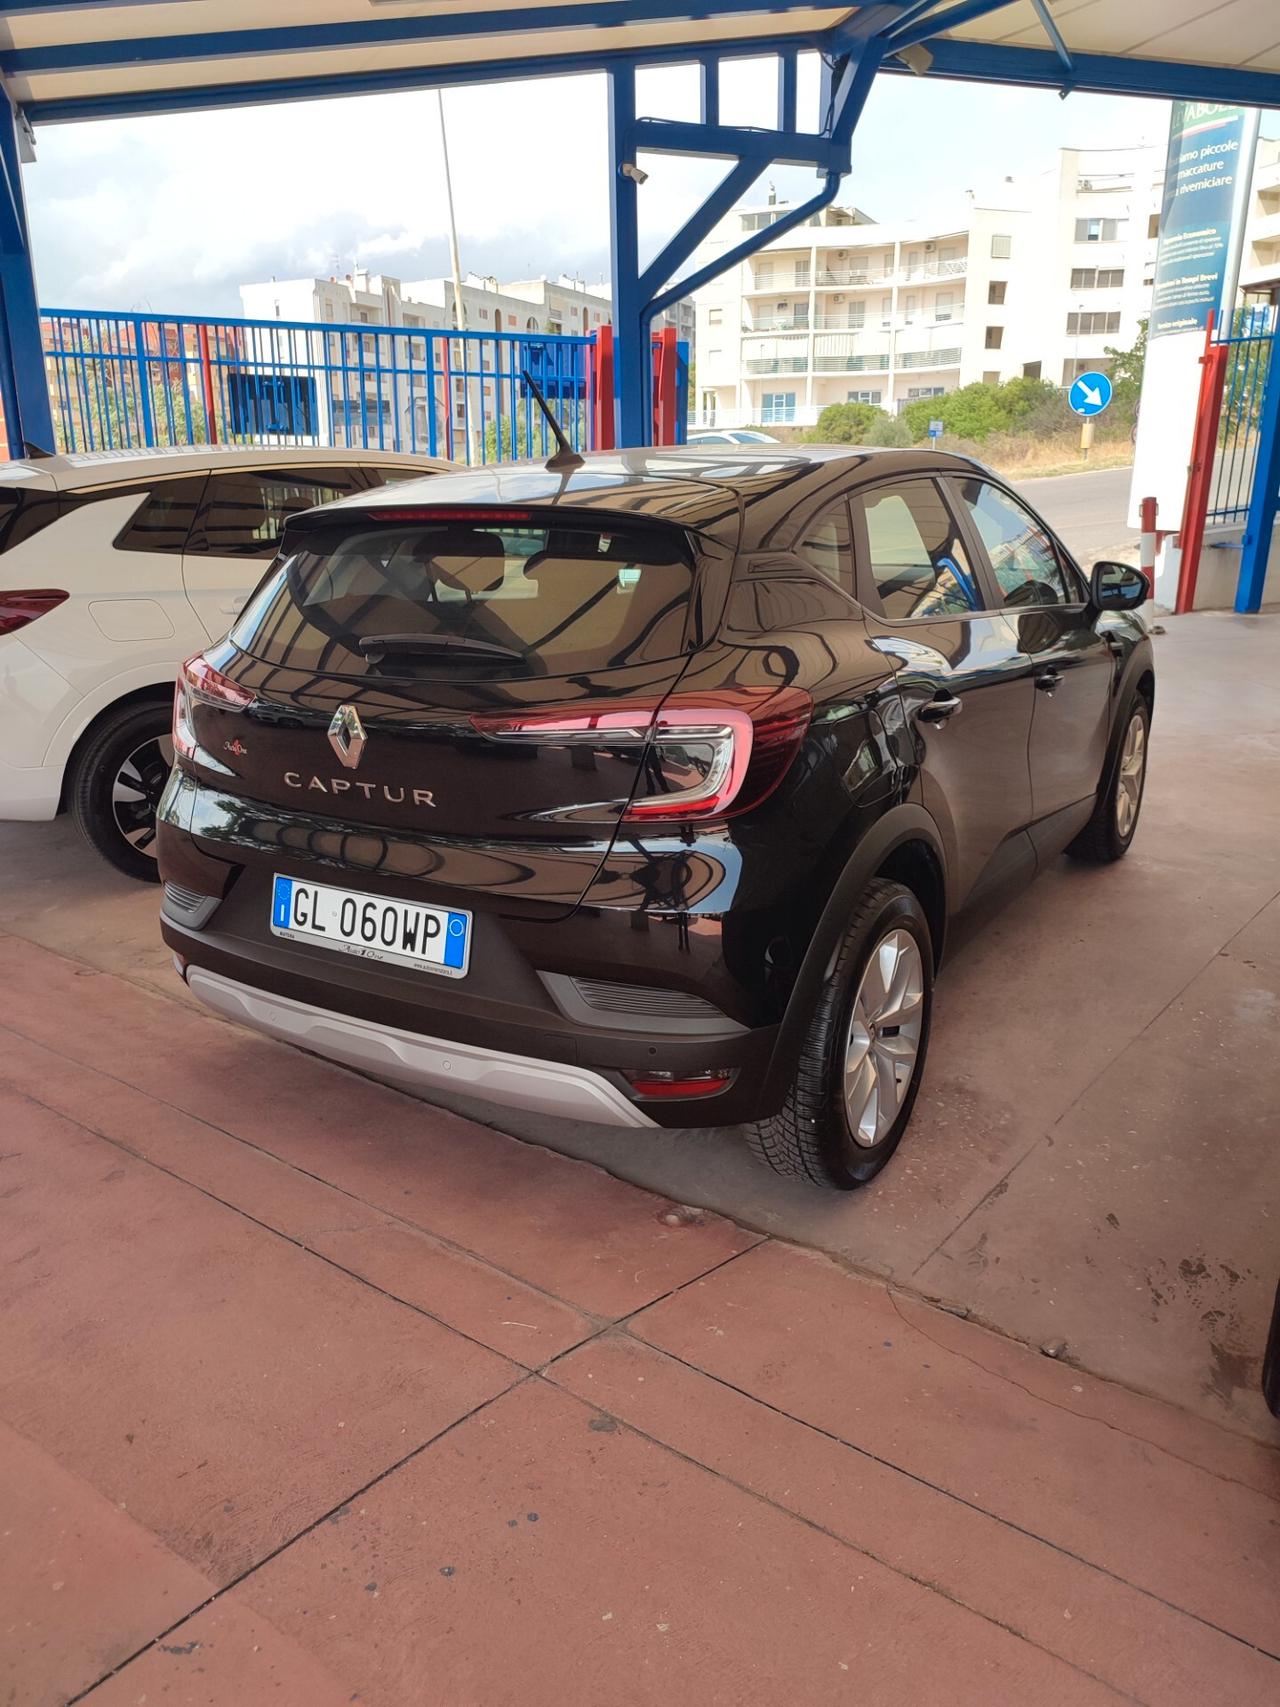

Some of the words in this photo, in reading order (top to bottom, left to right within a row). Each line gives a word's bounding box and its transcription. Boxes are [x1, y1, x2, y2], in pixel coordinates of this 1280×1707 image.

[1200, 141, 1239, 159] piccole
[1176, 161, 1225, 180] maccature
[283, 771, 437, 808] CAPTUR
[293, 887, 326, 932] GL
[339, 897, 441, 955] 060WP
